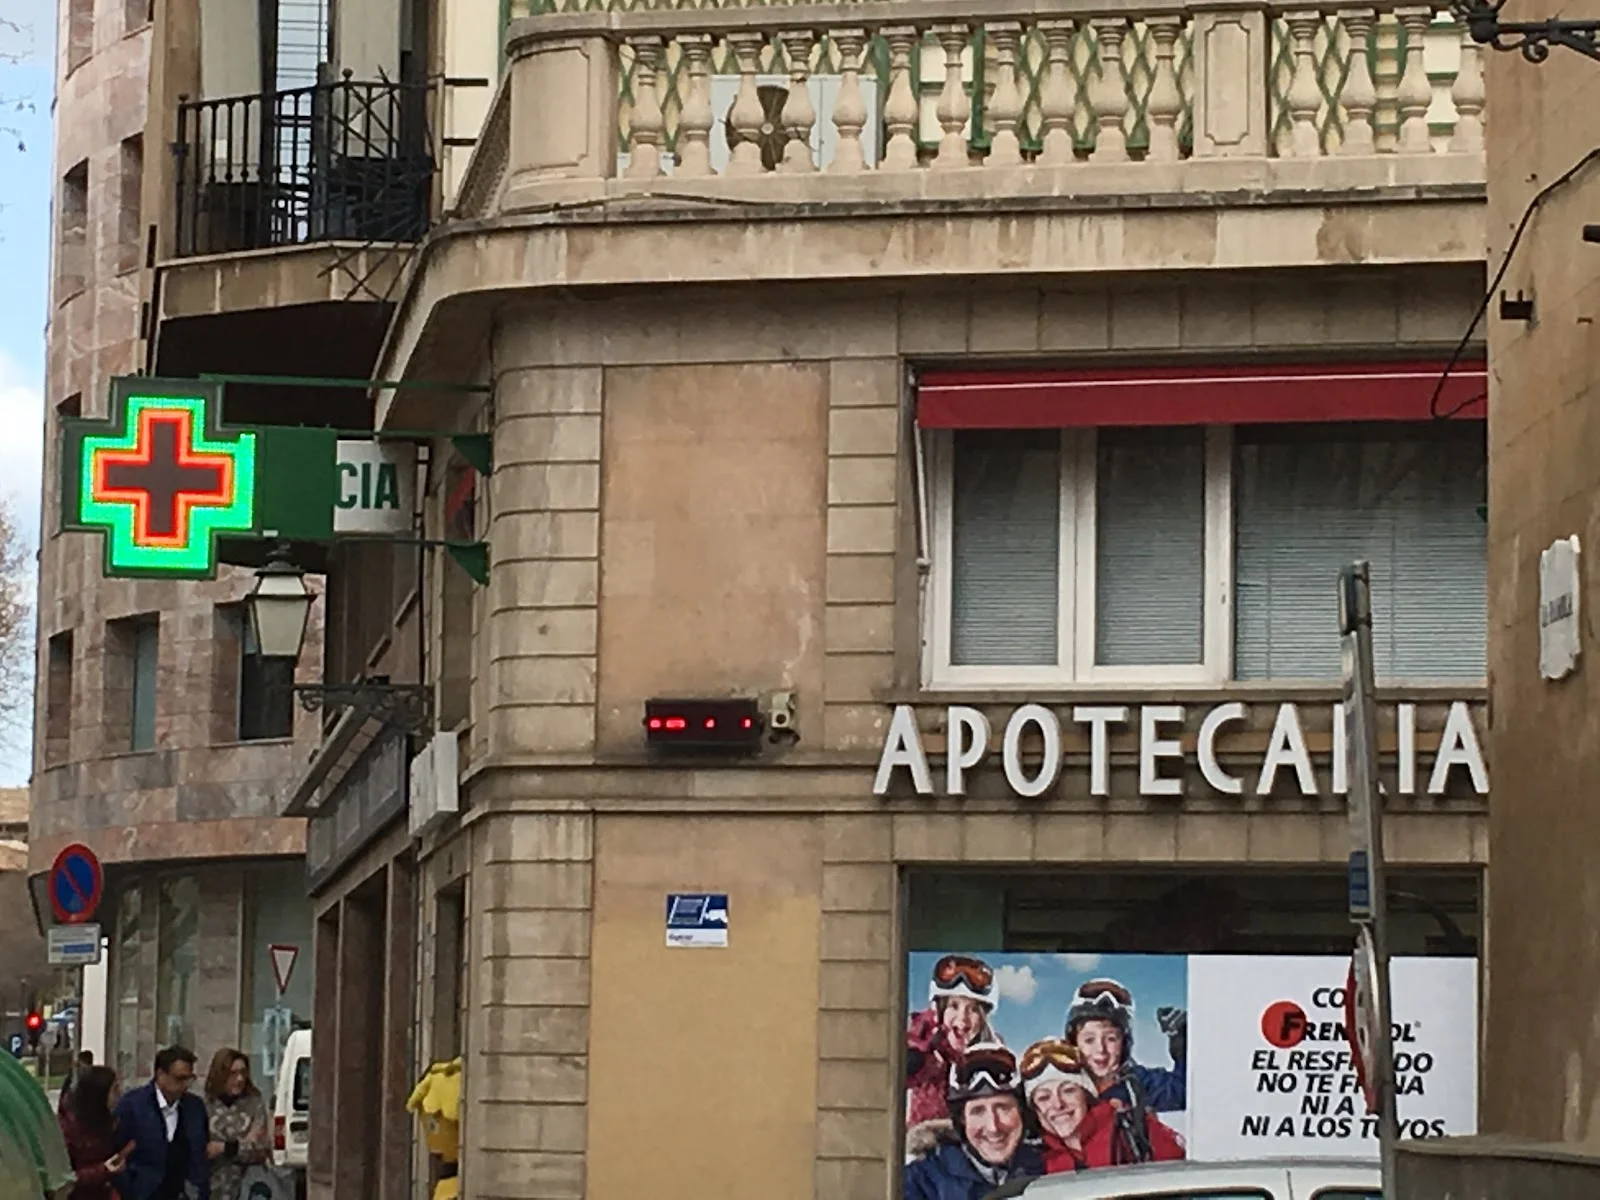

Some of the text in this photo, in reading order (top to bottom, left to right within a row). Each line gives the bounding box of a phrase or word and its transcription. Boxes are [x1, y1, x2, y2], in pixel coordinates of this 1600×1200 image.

[872, 702, 1489, 797] APOTECAIA
[1312, 987, 1346, 1008] CO
[1280, 1011, 1416, 1042] FRENOL
[1252, 1050, 1433, 1073] EL RESFDO
[1257, 1073, 1424, 1095] NO TE FNA
[1301, 1096, 1354, 1116] NI A
[1241, 1116, 1270, 1136] NI
[1275, 1117, 1295, 1137] A
[1303, 1117, 1351, 1138] LOS
